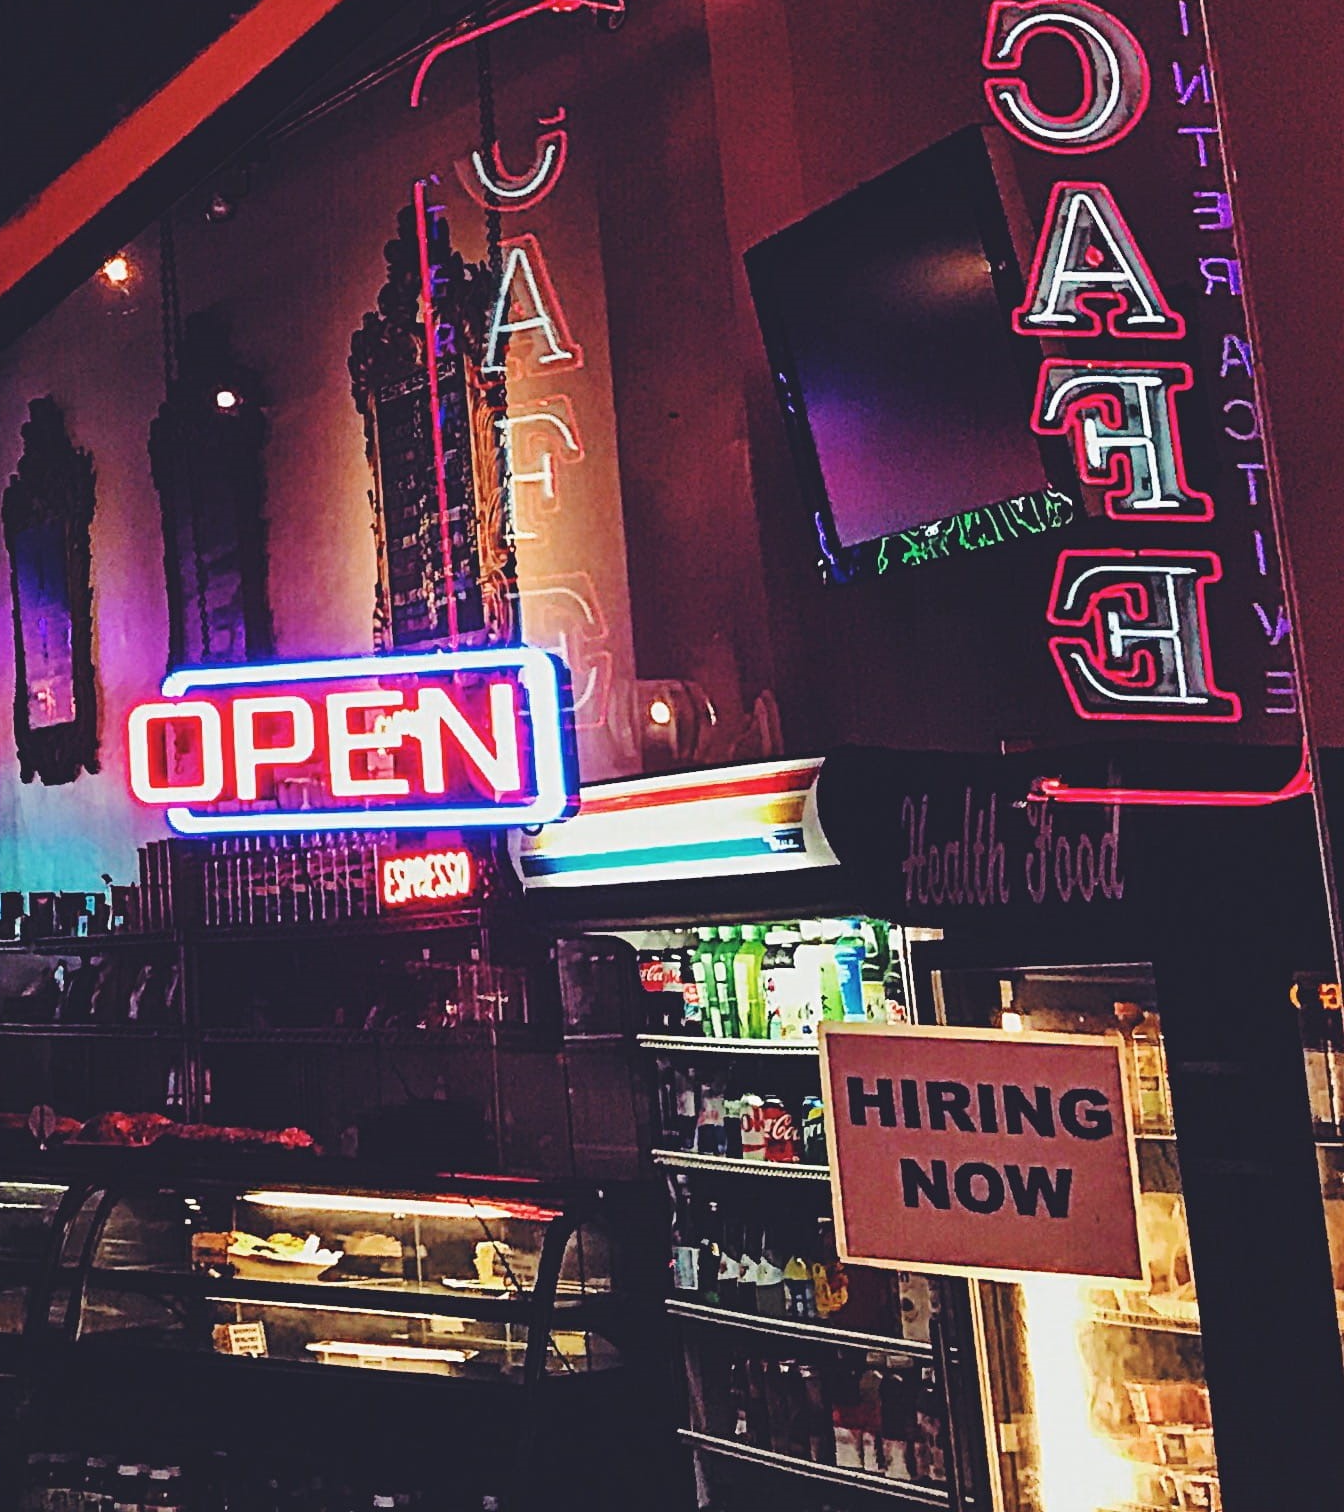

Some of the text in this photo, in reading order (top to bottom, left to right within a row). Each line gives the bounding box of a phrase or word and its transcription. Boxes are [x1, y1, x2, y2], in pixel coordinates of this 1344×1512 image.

[128, 682, 523, 805] OPEN
[902, 763, 1124, 905] Health Food
[383, 851, 471, 904] ESPRESSO
[846, 1076, 1113, 1141] HIRING
[900, 1158, 1073, 1219] NOW
